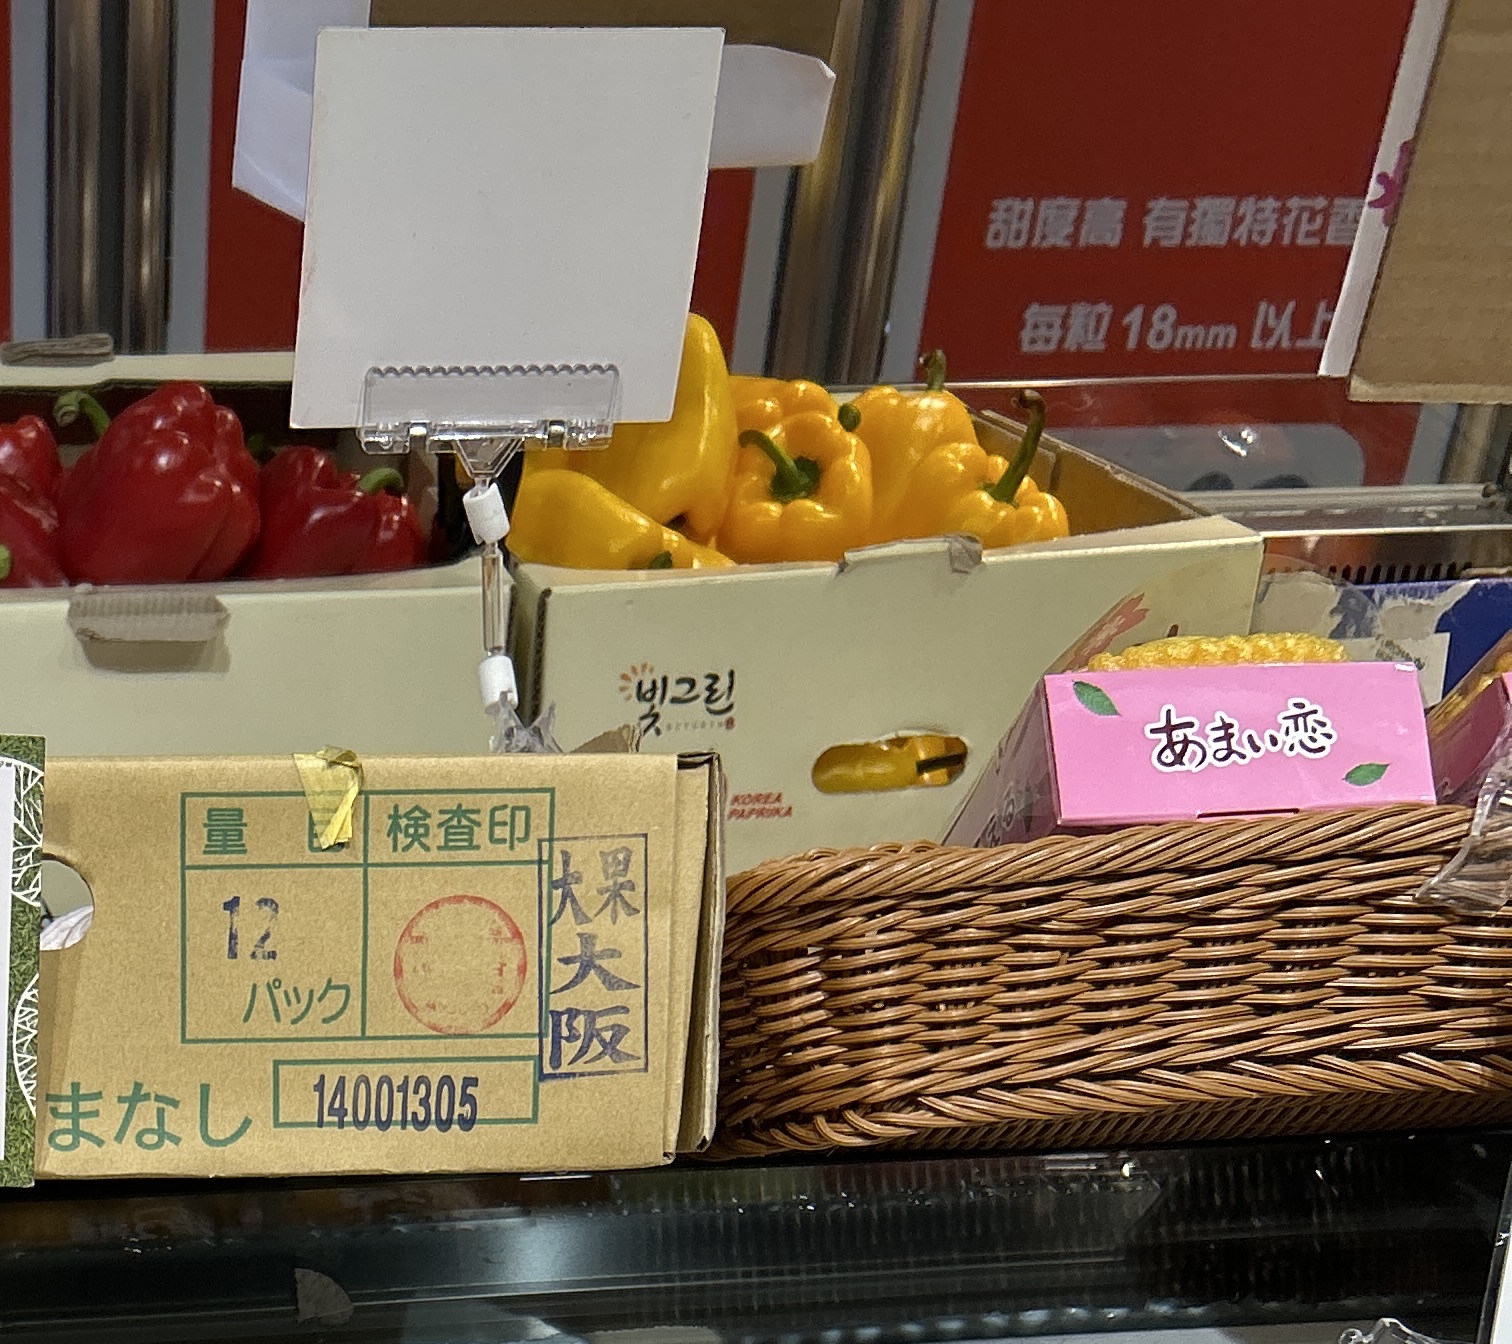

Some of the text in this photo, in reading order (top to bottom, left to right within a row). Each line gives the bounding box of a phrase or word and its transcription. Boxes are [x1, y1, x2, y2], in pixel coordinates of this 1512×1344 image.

[986, 197, 1127, 250] 甜度高
[1021, 299, 1334, 354] 每粒 18mm 以上
[1145, 698, 1336, 772] あまい恋
[387, 804, 532, 853] 検査印
[221, 896, 281, 961] 12
[243, 977, 352, 1025] パック
[313, 1076, 481, 1132] 14001305
